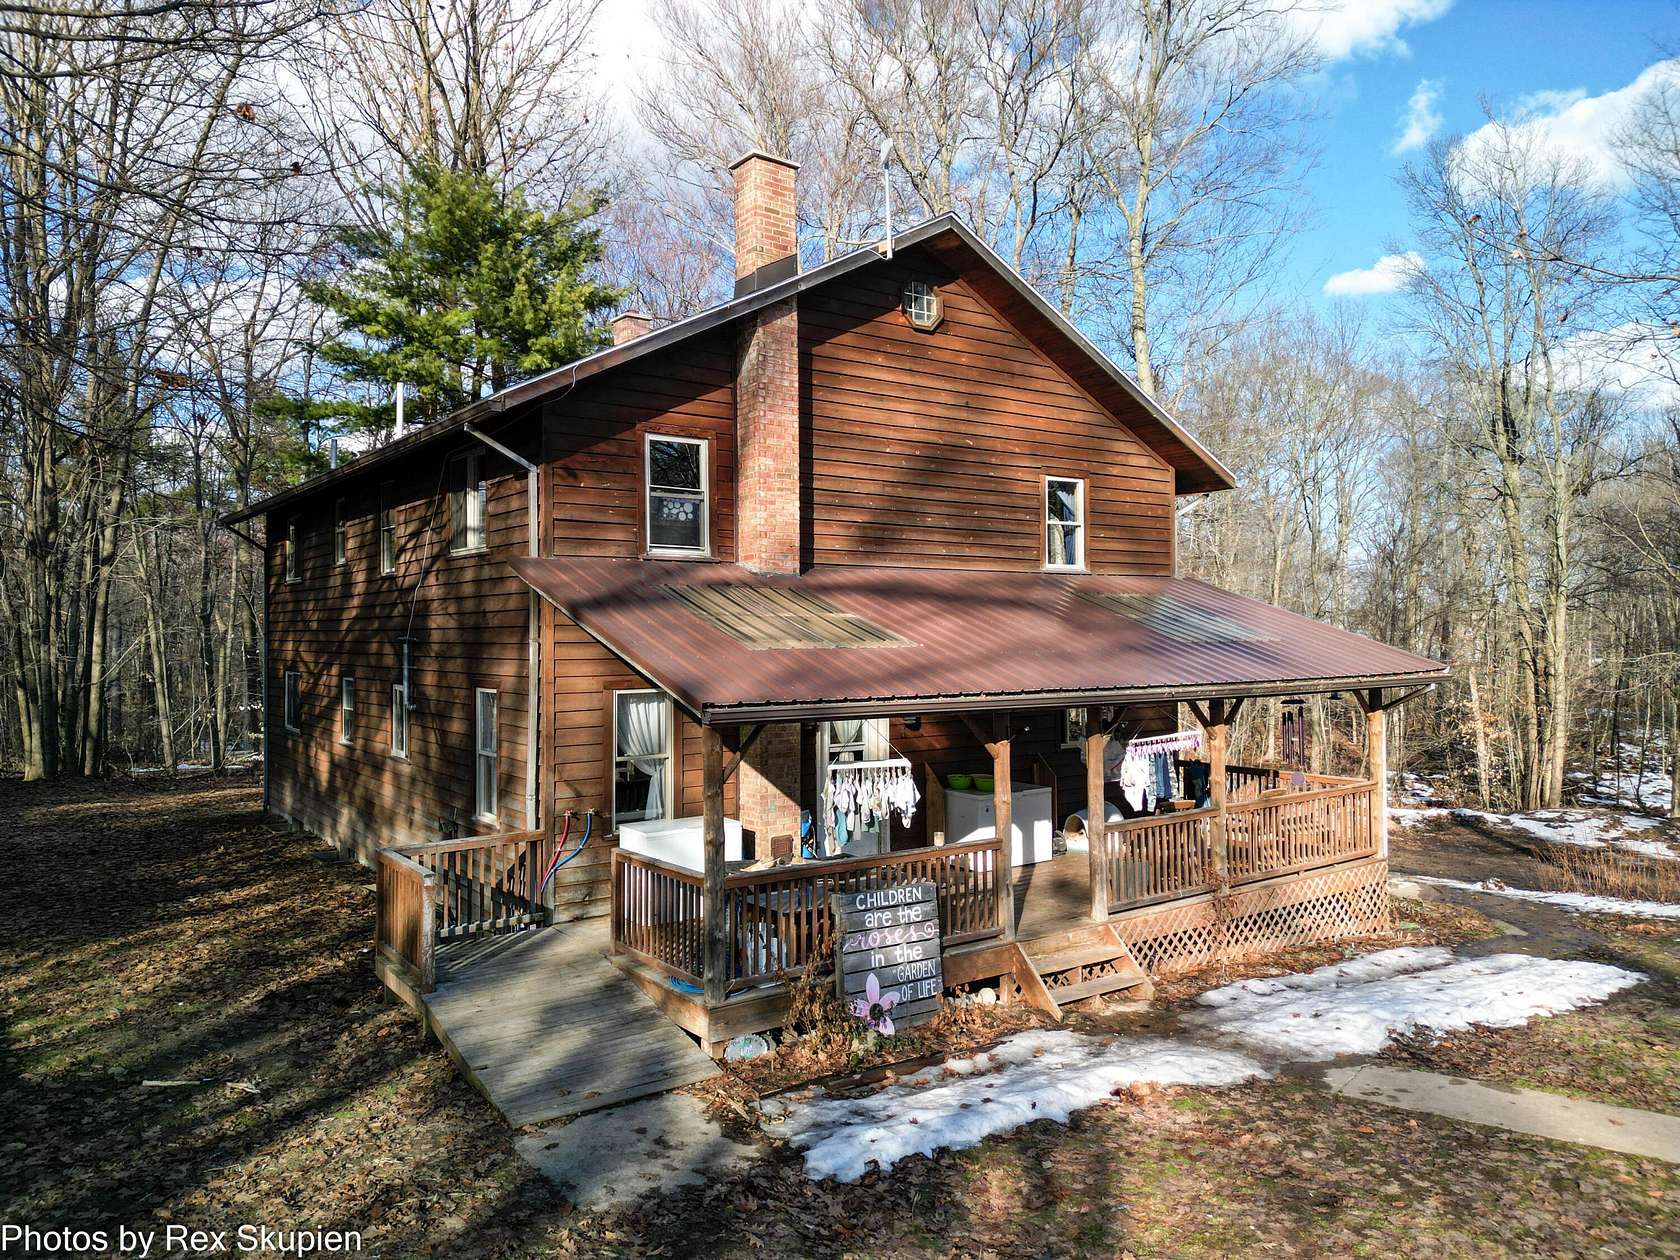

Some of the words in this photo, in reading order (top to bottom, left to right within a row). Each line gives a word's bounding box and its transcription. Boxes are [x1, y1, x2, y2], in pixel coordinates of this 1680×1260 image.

[856, 886, 922, 910] CHILDREN
[864, 911, 892, 928] are
[897, 905, 922, 922] the
[871, 951, 885, 968] in
[894, 945, 922, 962] the
[901, 983, 914, 1001] OF
